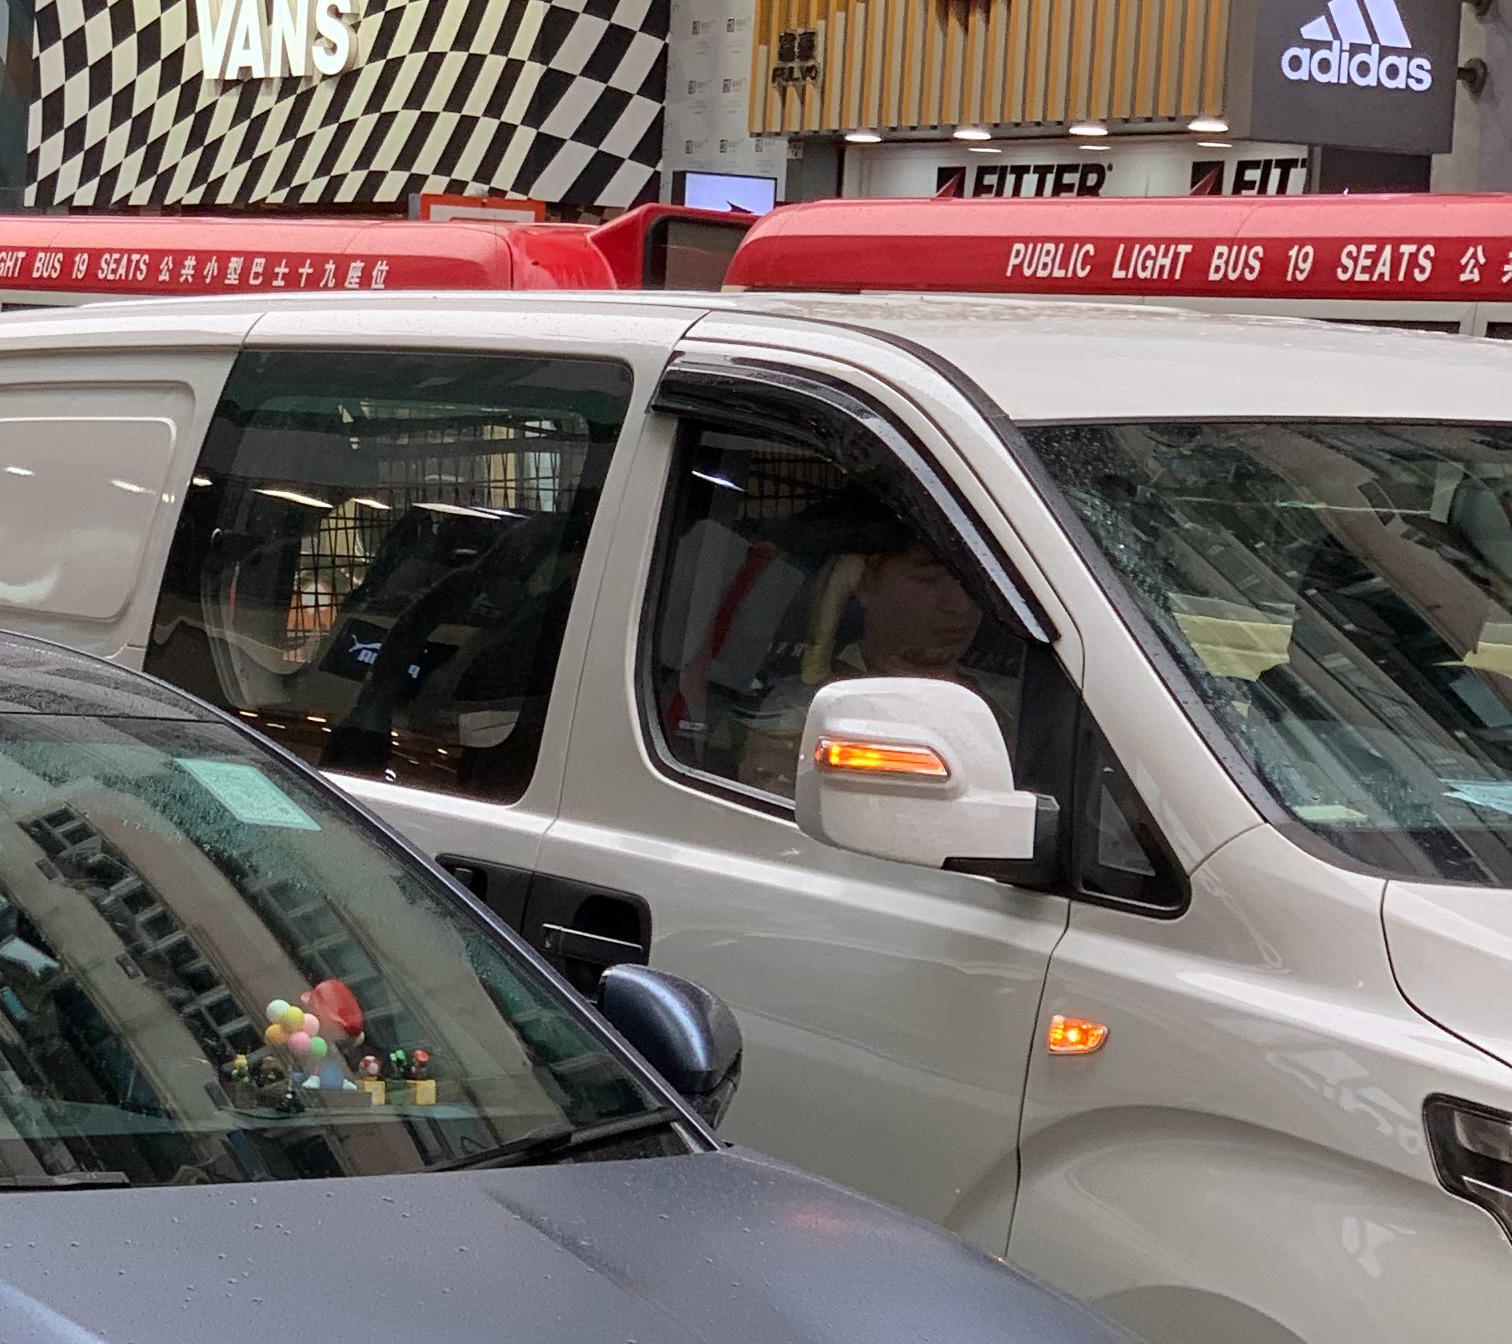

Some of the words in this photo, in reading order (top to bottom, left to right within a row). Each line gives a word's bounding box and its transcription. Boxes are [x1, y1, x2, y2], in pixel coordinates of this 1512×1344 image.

[1281, 40, 1433, 92] adidas
[972, 163, 1105, 198] FITTER
[1232, 158, 1307, 196] FIT
[32, 251, 65, 279] BUS
[72, 252, 89, 280] 19
[97, 252, 150, 281] SEATS
[158, 254, 389, 290] 公共小型巴士十九座位
[1006, 242, 1095, 279] PUBLIC
[1112, 244, 1192, 281] LIGHT
[1208, 244, 1264, 281] BUS
[1287, 244, 1315, 281] 19
[1337, 244, 1435, 282] SEATS
